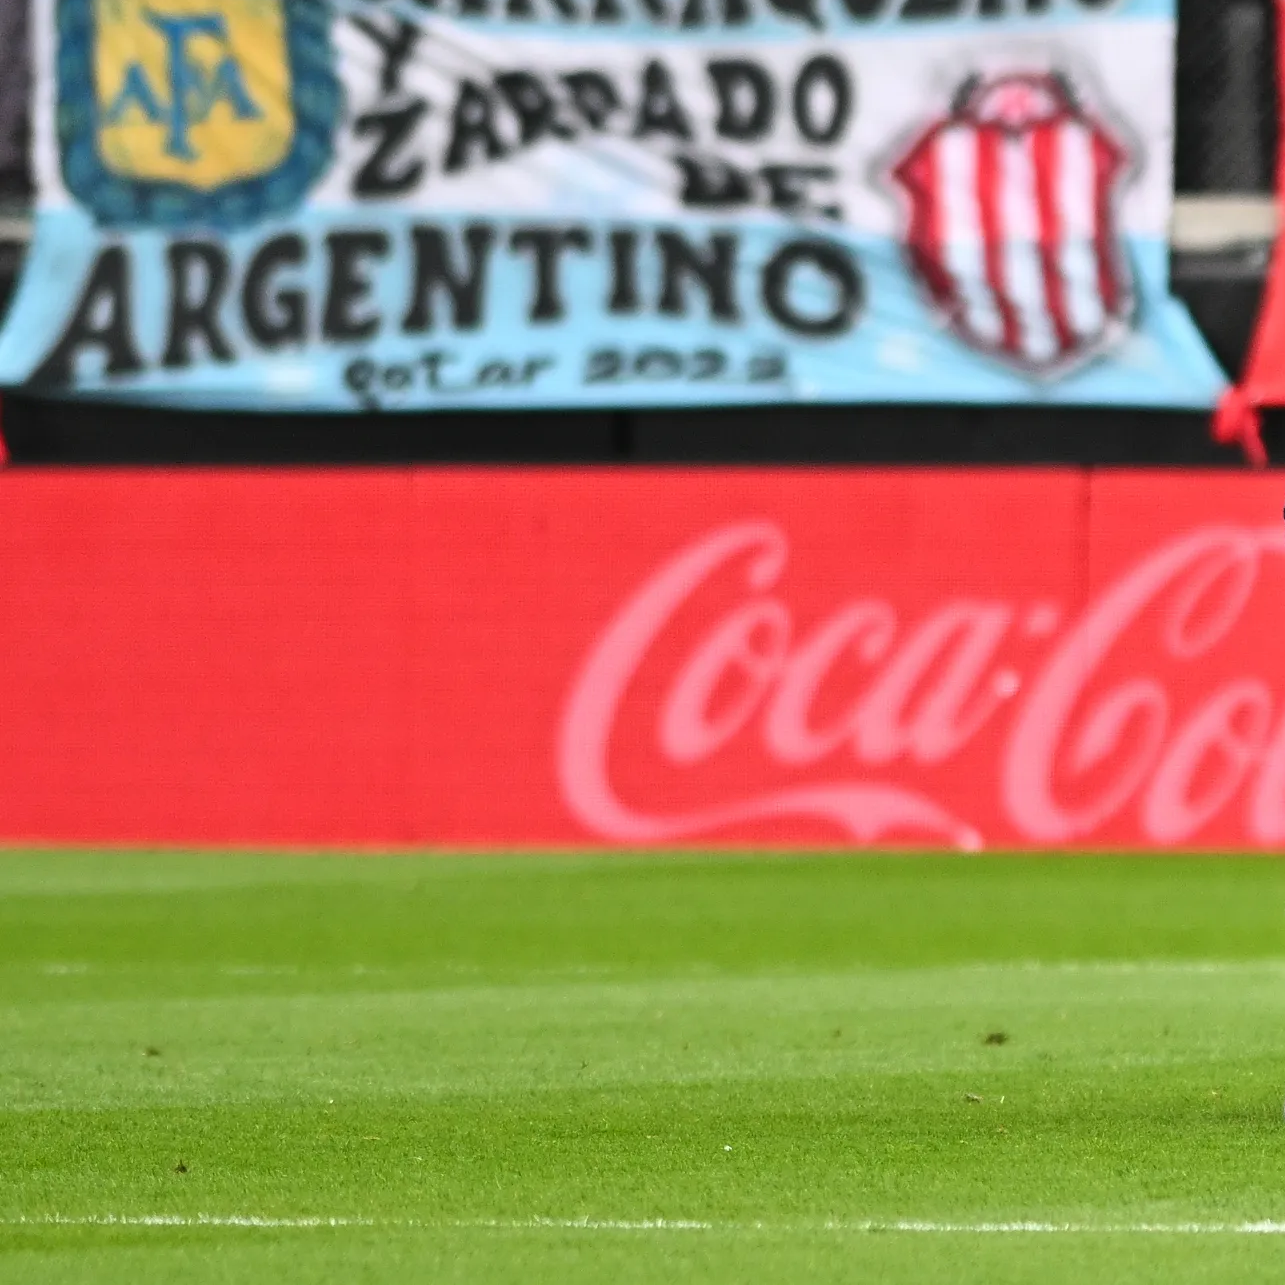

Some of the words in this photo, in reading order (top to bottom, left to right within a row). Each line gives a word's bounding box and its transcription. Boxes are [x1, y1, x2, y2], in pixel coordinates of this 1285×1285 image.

[98, 11, 264, 163] AFA
[348, 16, 419, 93] Y
[37, 220, 865, 386] ARGENTINO
